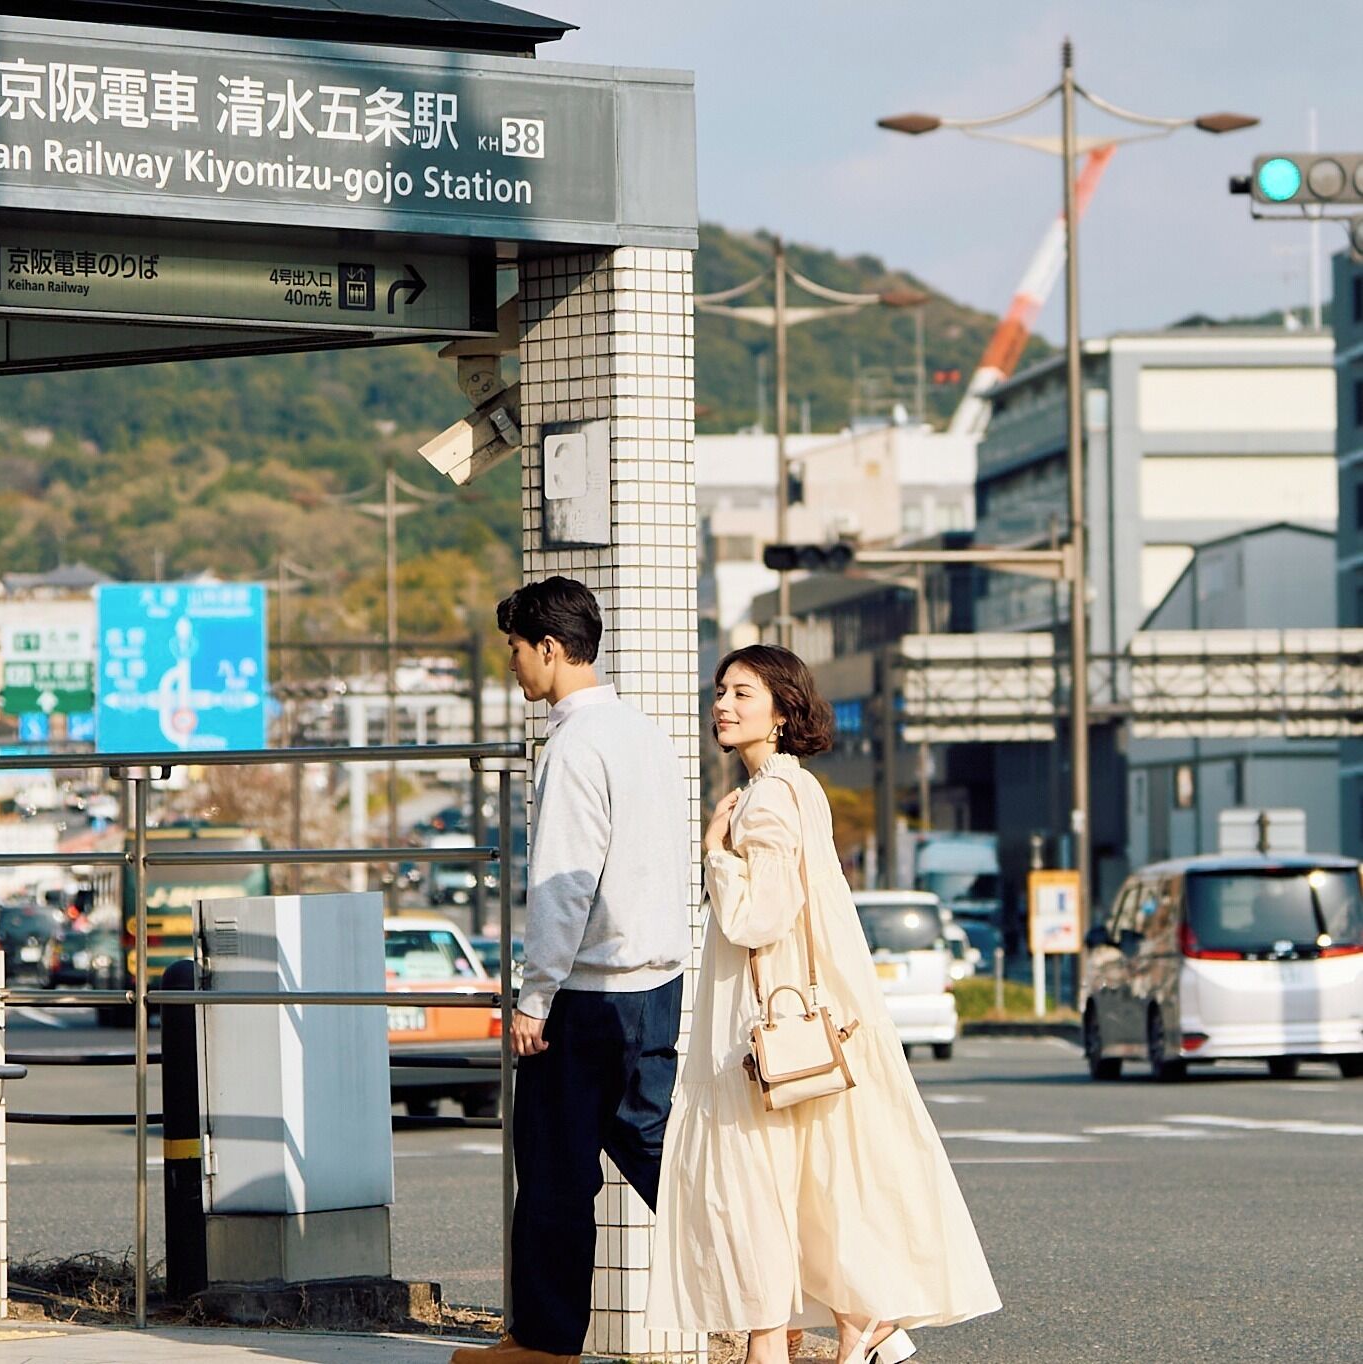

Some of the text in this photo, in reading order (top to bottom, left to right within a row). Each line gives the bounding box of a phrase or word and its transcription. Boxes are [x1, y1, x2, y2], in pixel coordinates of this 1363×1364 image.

[216, 75, 460, 151] 清水五条駅
[477, 121, 541, 155] KH 38
[43, 139, 174, 188] Railway
[184, 149, 414, 204] Kiyomizu-gojo
[423, 166, 533, 205] Station
[7, 246, 160, 280] 京阪電車のりば
[269, 269, 333, 288] 4号出入口
[7, 279, 90, 296] Keihan Railway
[284, 288, 333, 308] 40m先
